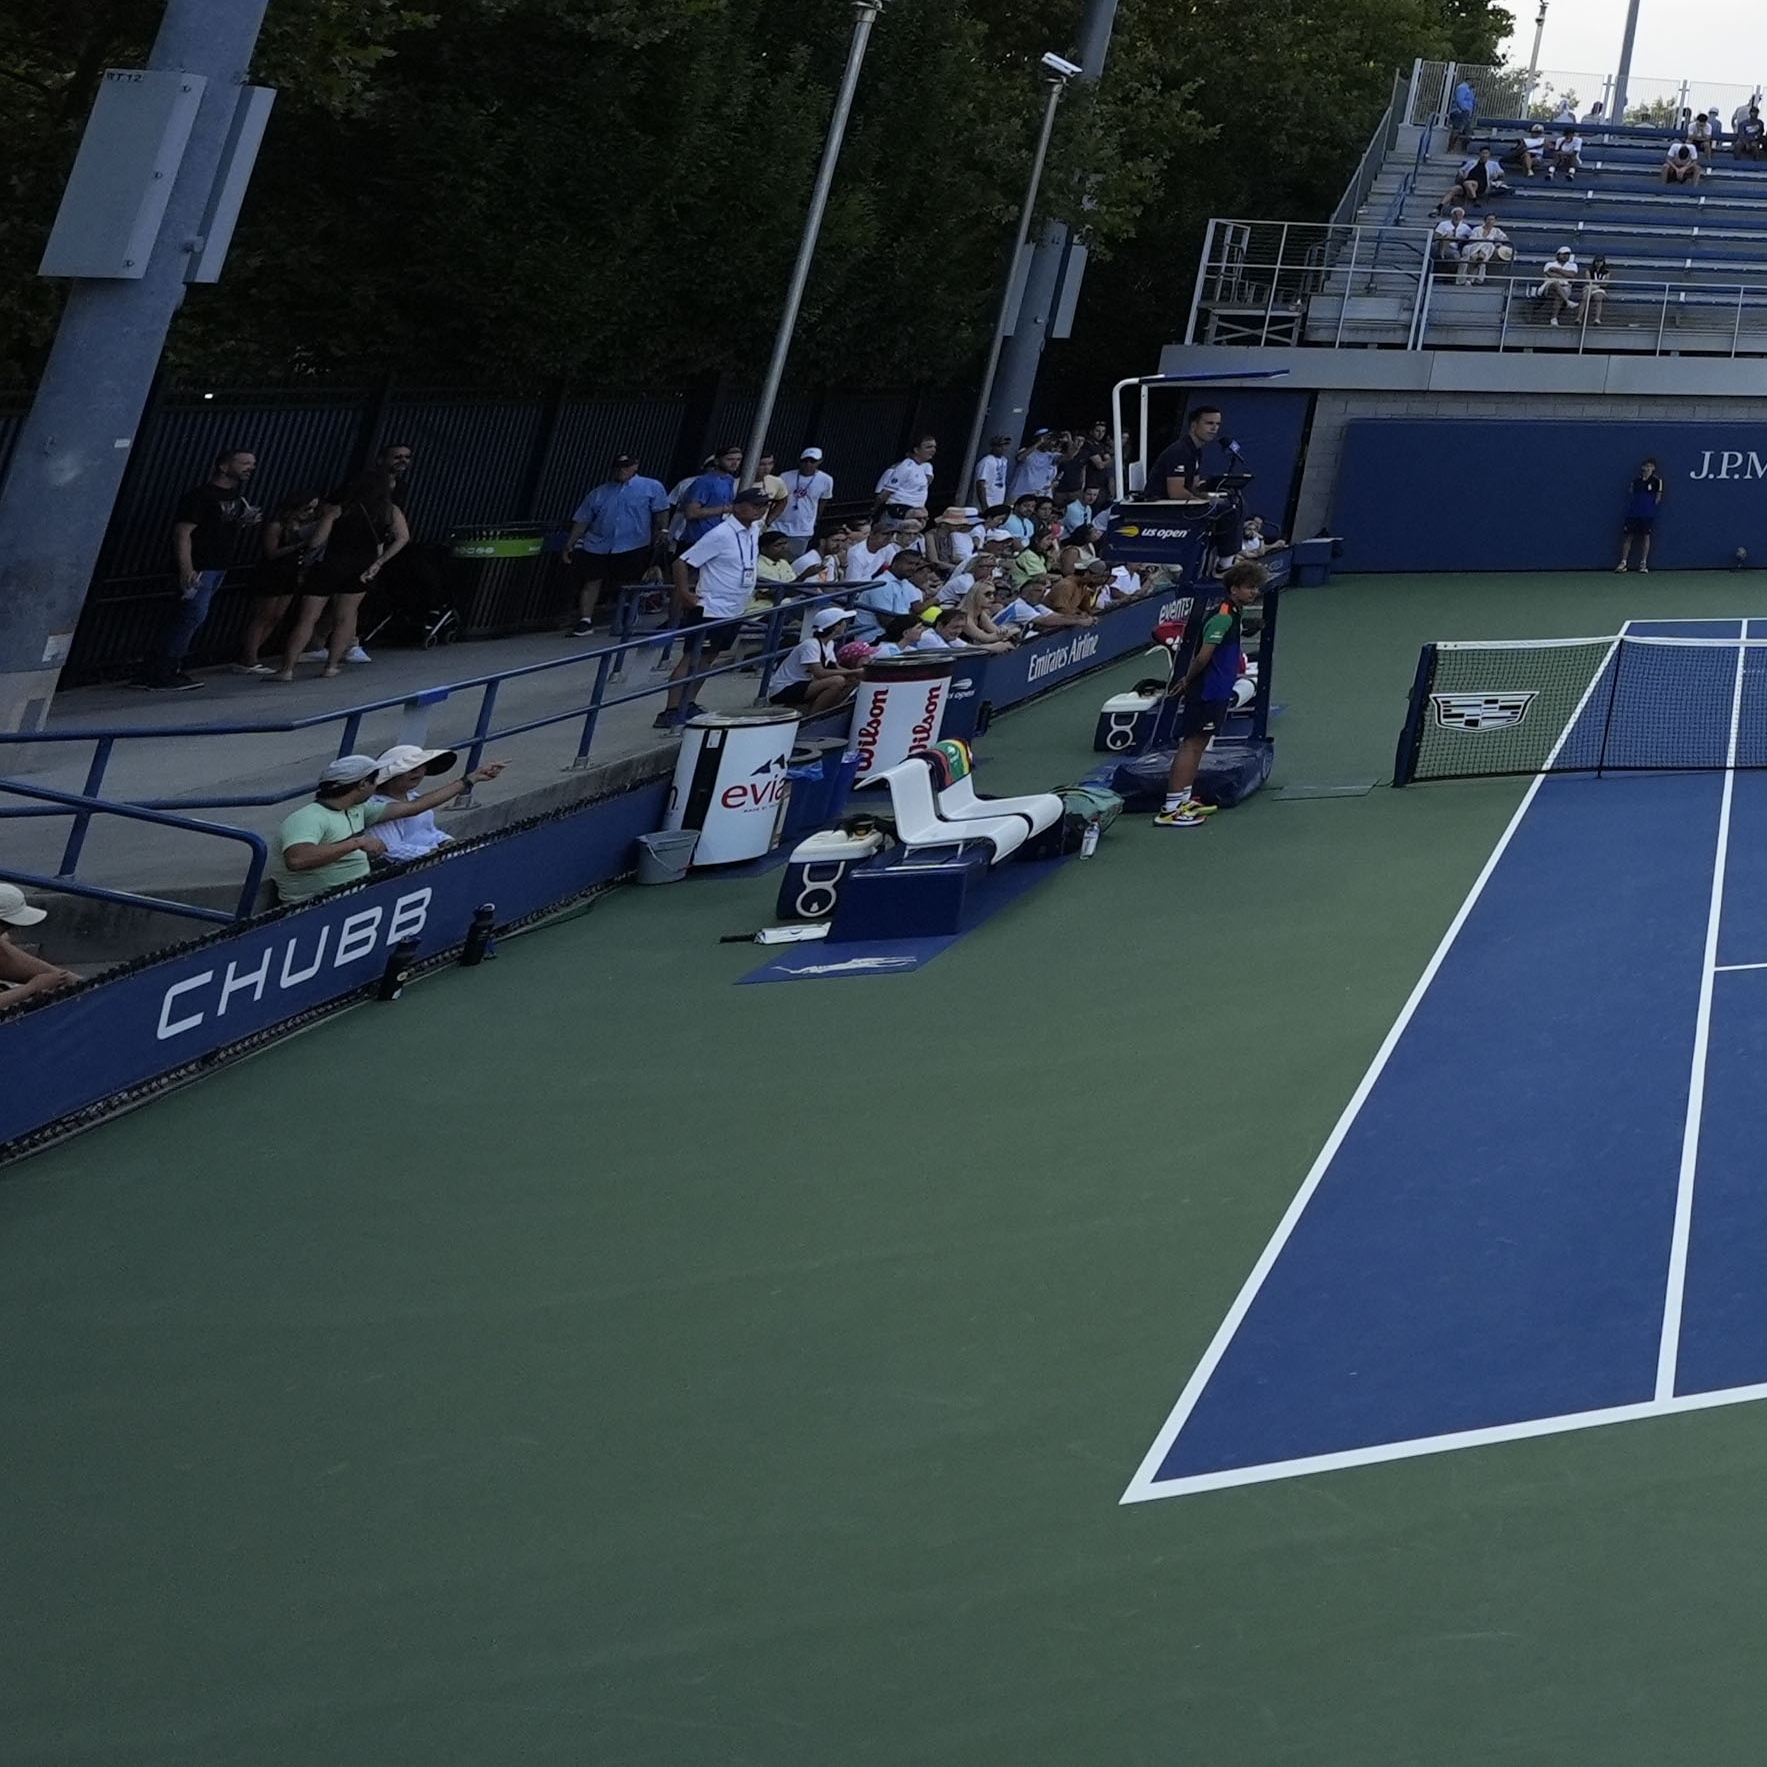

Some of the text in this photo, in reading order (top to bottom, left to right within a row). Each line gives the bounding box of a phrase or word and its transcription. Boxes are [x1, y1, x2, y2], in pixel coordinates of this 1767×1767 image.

[1142, 527, 1187, 540] us open
[1027, 632, 1099, 682] Emirates Airline
[858, 688, 889, 771] Wilson
[721, 773, 788, 809] evia
[156, 886, 433, 1041] CHUBB
